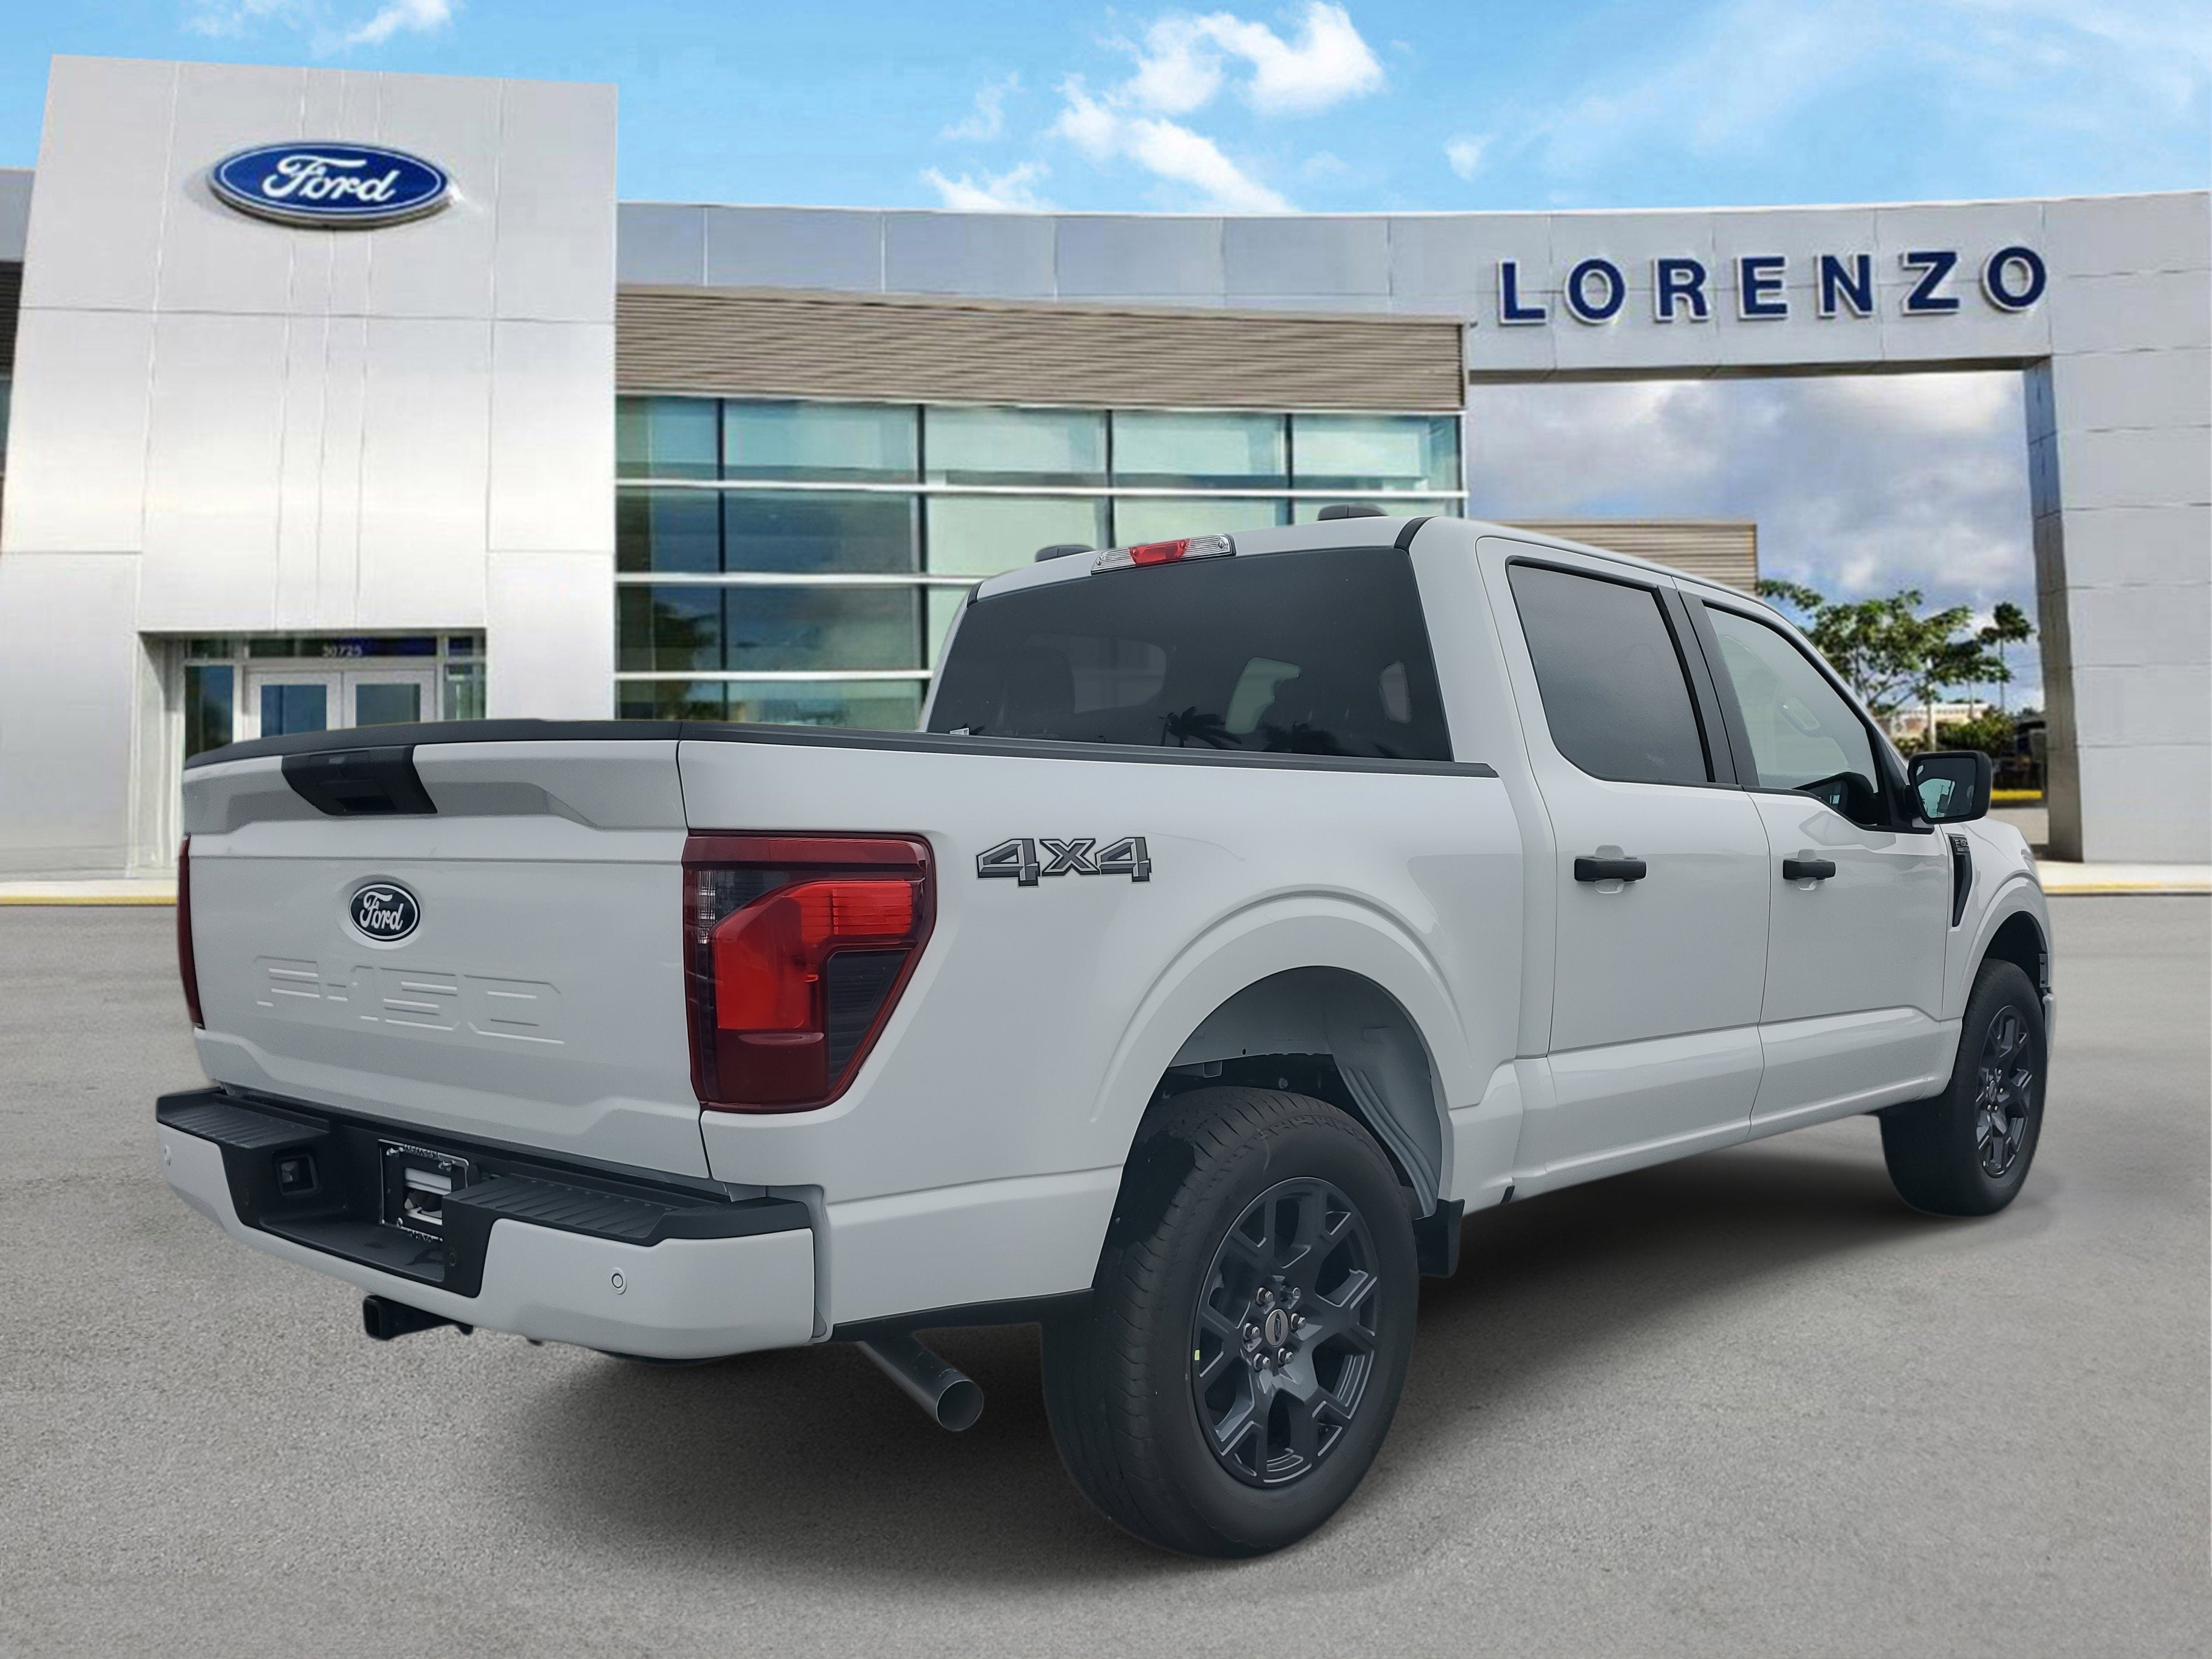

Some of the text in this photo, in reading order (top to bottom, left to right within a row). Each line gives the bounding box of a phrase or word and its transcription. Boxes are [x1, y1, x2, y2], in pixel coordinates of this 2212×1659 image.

[262, 155, 401, 202] Ford
[1497, 246, 2047, 325] LORENZO
[360, 891, 404, 930] Ford
